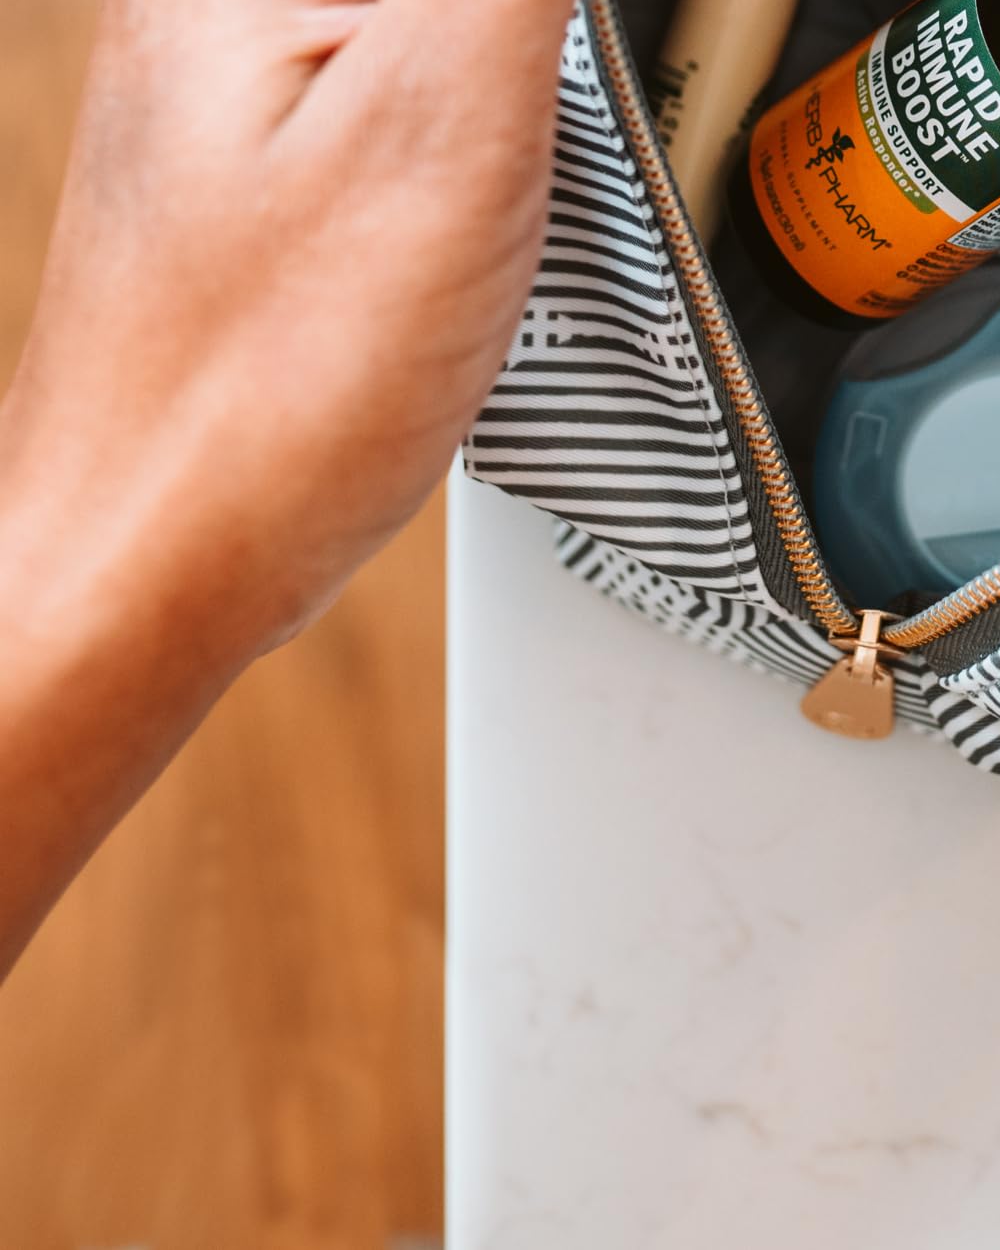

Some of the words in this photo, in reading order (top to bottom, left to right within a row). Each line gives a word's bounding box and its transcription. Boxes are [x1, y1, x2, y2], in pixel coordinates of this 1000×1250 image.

[805, 85, 823, 147] ERB
[857, 69, 869, 114] Active
[872, 50, 892, 122] IMMUNE
[887, 125, 944, 196] SUPPORT
[917, 10, 1000, 162] IMMUNE
